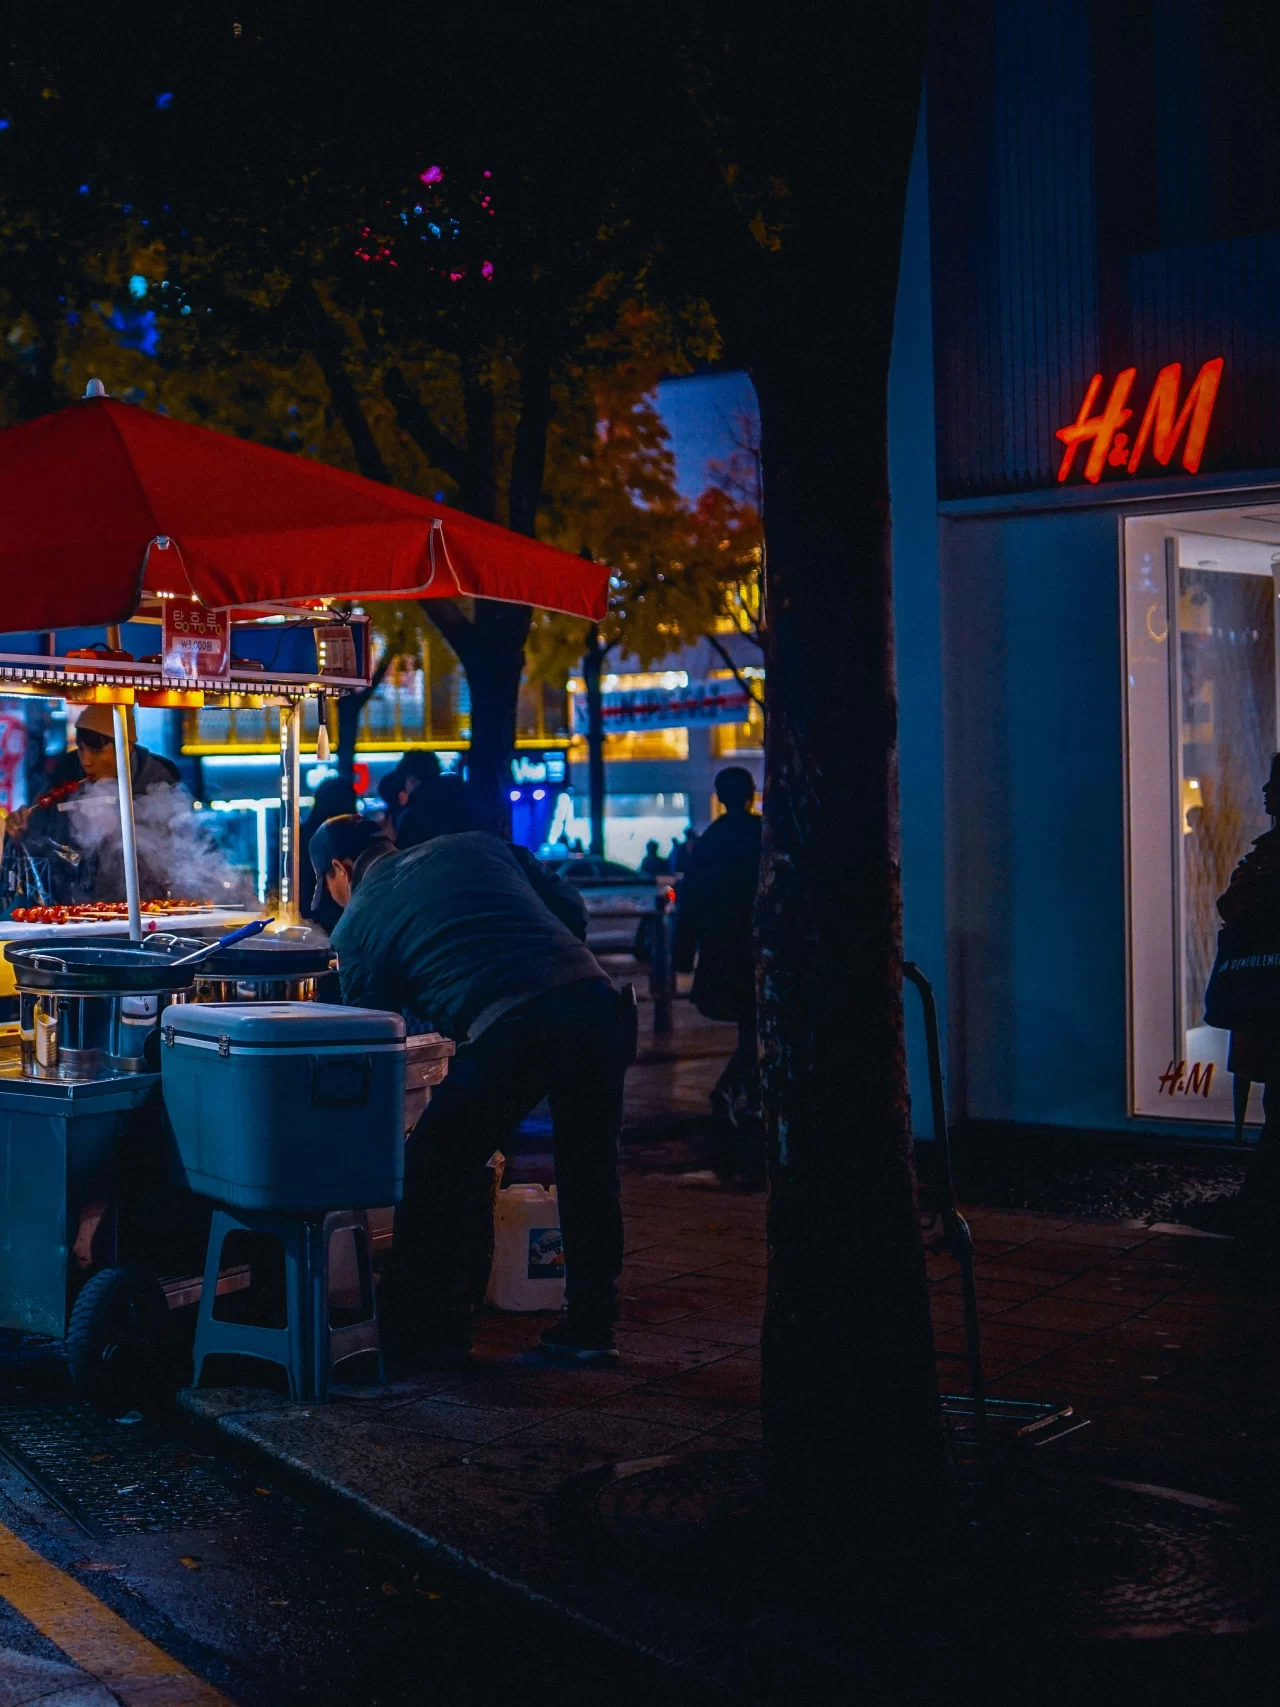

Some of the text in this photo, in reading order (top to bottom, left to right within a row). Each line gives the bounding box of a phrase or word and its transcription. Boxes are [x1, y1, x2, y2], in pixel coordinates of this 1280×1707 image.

[1055, 357, 1224, 484] H&M
[173, 609, 217, 632] 탕후루
[1158, 1060, 1215, 1099] H&M
